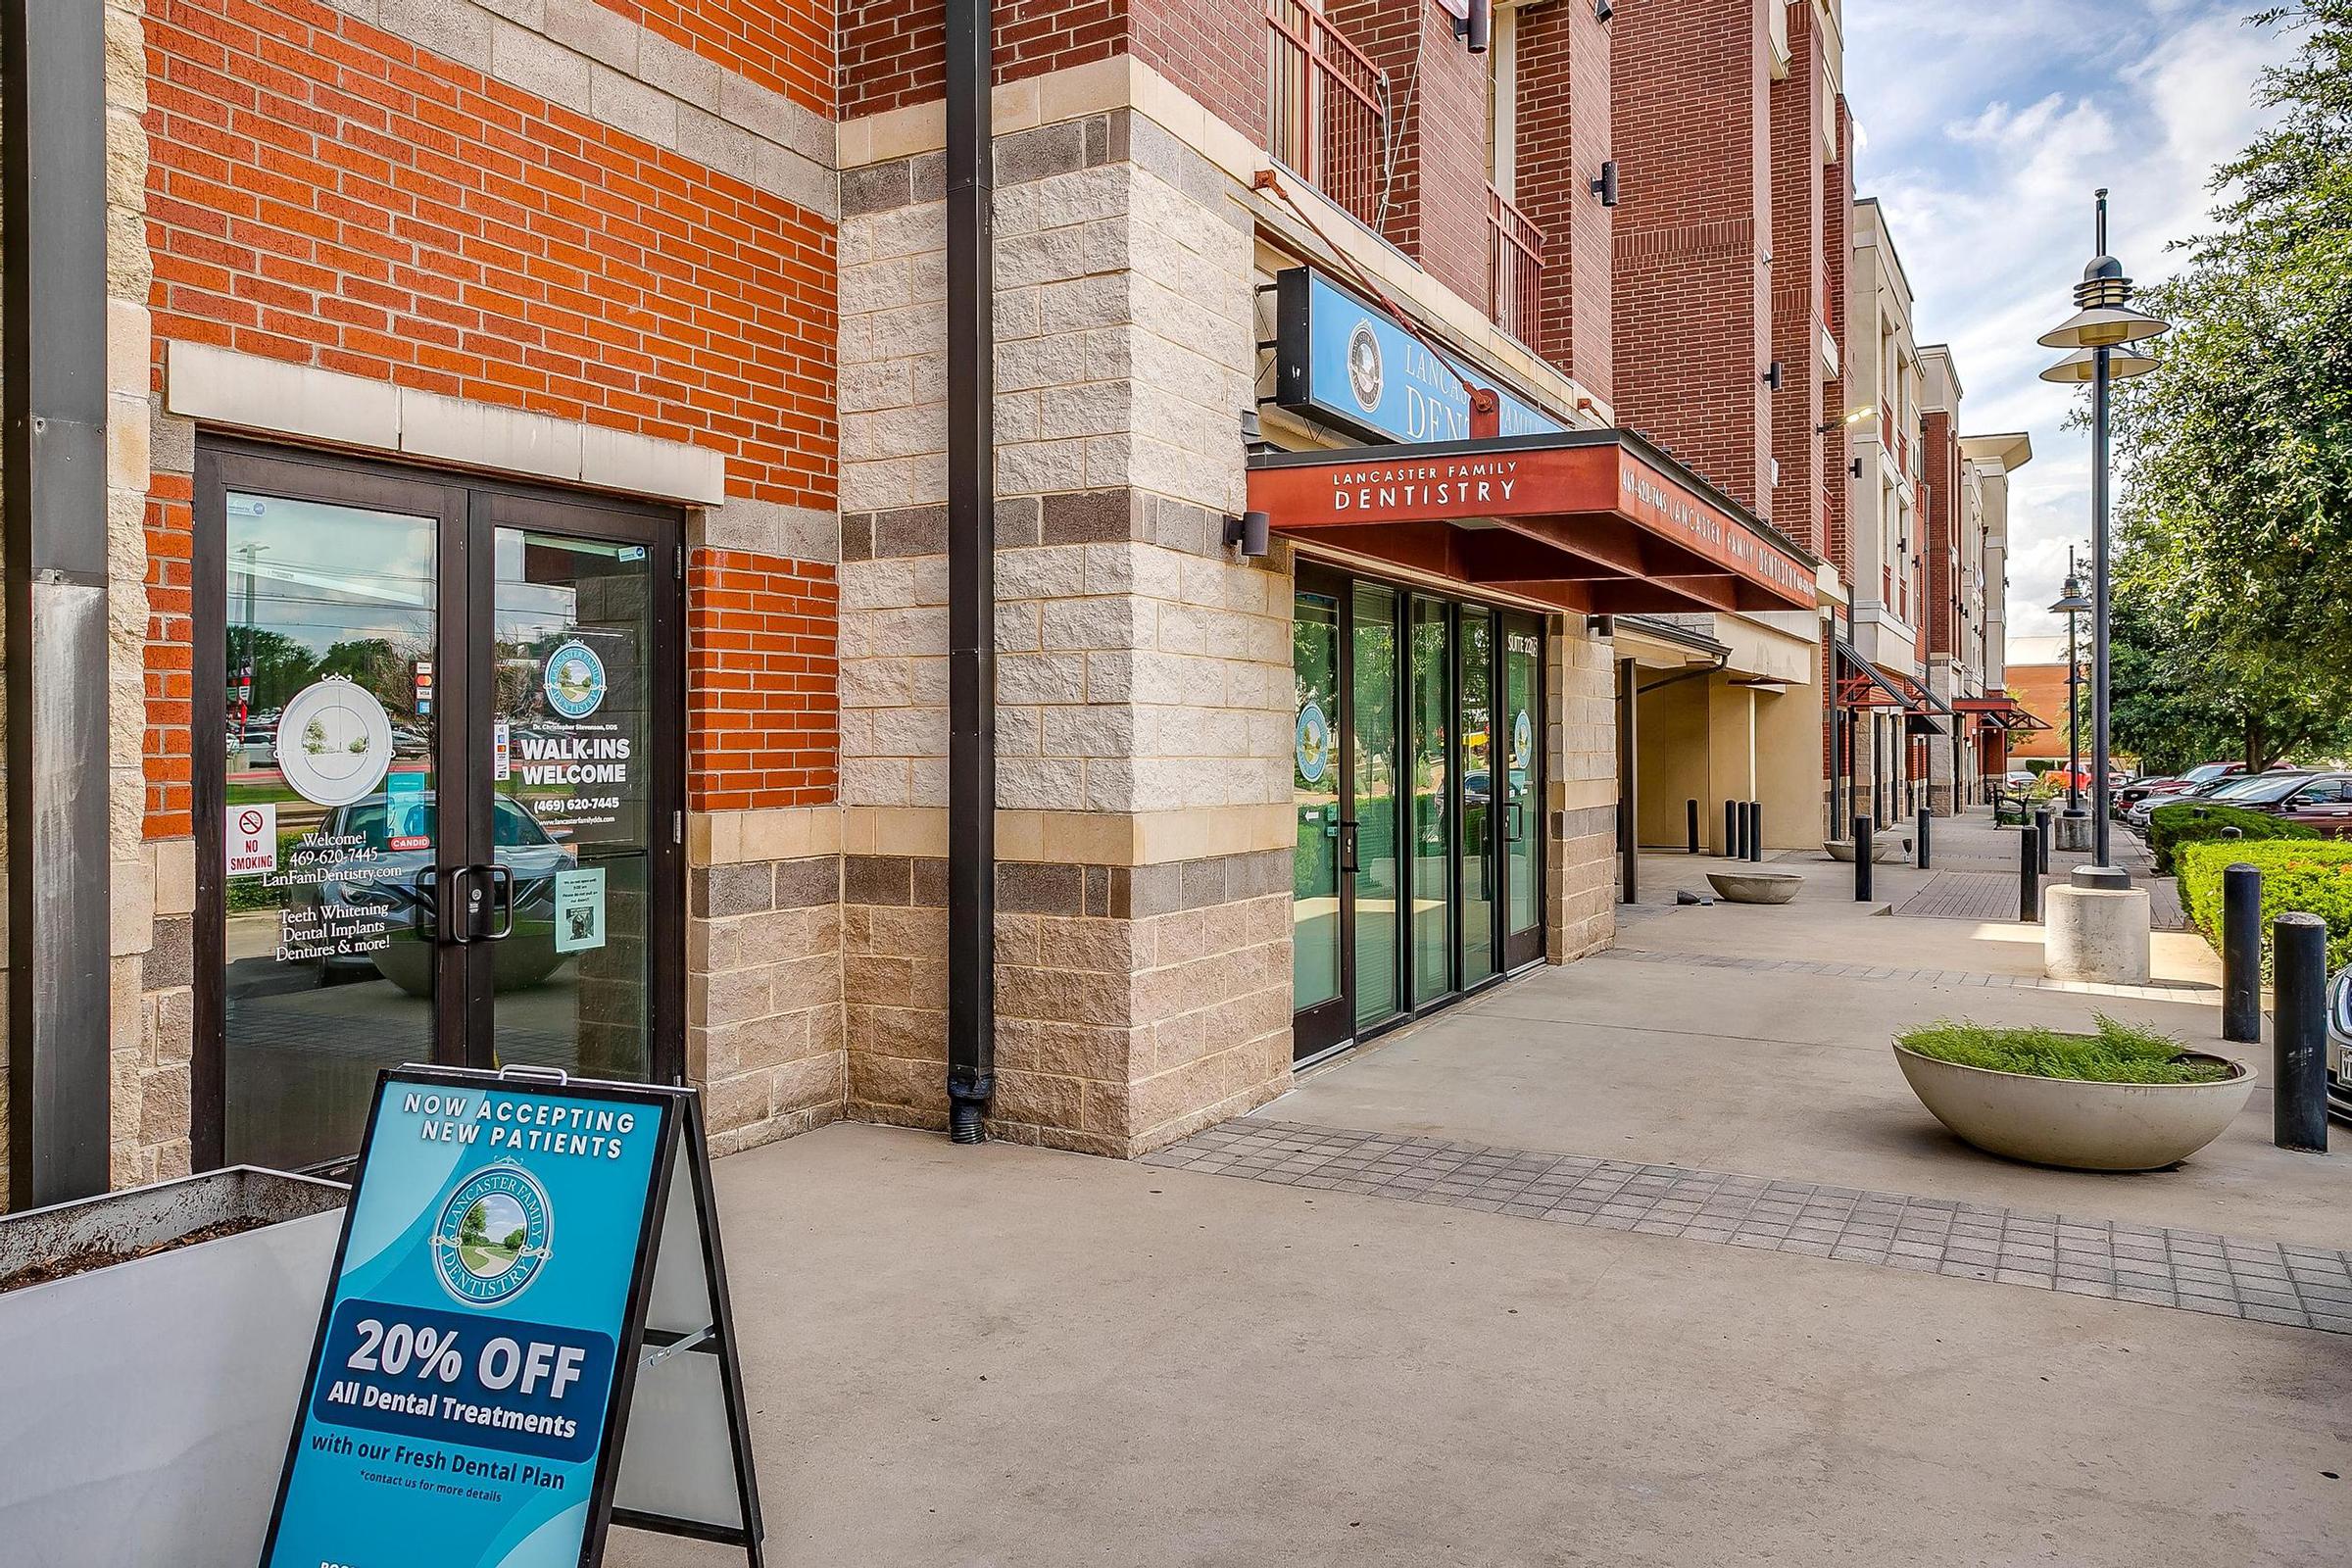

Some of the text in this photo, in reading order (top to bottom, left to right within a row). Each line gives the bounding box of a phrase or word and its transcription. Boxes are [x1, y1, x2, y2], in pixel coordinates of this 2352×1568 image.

[1333, 462, 1517, 485] LANCASTER FAMILY
[1335, 478, 1515, 510] DENTISTRY
[1669, 496, 1720, 547] LANCASTER
[1507, 635, 1524, 653] SUITE
[553, 691, 598, 711] DENTISTRY
[520, 738, 630, 760] WALK-INS
[522, 764, 626, 785] WELCOME
[533, 797, 619, 813] (469) 620-7445
[245, 840, 259, 854] NO
[302, 830, 367, 848] Welcome!
[392, 839, 428, 848] CANDID
[230, 855, 273, 871] SMOKING
[290, 847, 378, 867] 469-620-7445
[262, 865, 403, 887] LanFamDentistry.com
[278, 903, 390, 925] Teeth Whitening
[282, 920, 385, 943] Dental Implants
[275, 935, 390, 962] Dentures & more!
[404, 1093, 634, 1133] NOW ACCEPTING
[421, 1120, 622, 1159] NEW PATIENTS
[447, 1177, 542, 1239] LANCASTER FAMILY
[443, 1252, 530, 1296] DENTISTRY
[347, 1319, 585, 1398] 20% OFF
[327, 1380, 577, 1439] All Dental Treatments
[312, 1433, 565, 1491] with our Fresh Dental Plan
[405, 1477, 417, 1489] us
[418, 1479, 434, 1492] for
[436, 1483, 464, 1496] more
[466, 1487, 502, 1502] details
